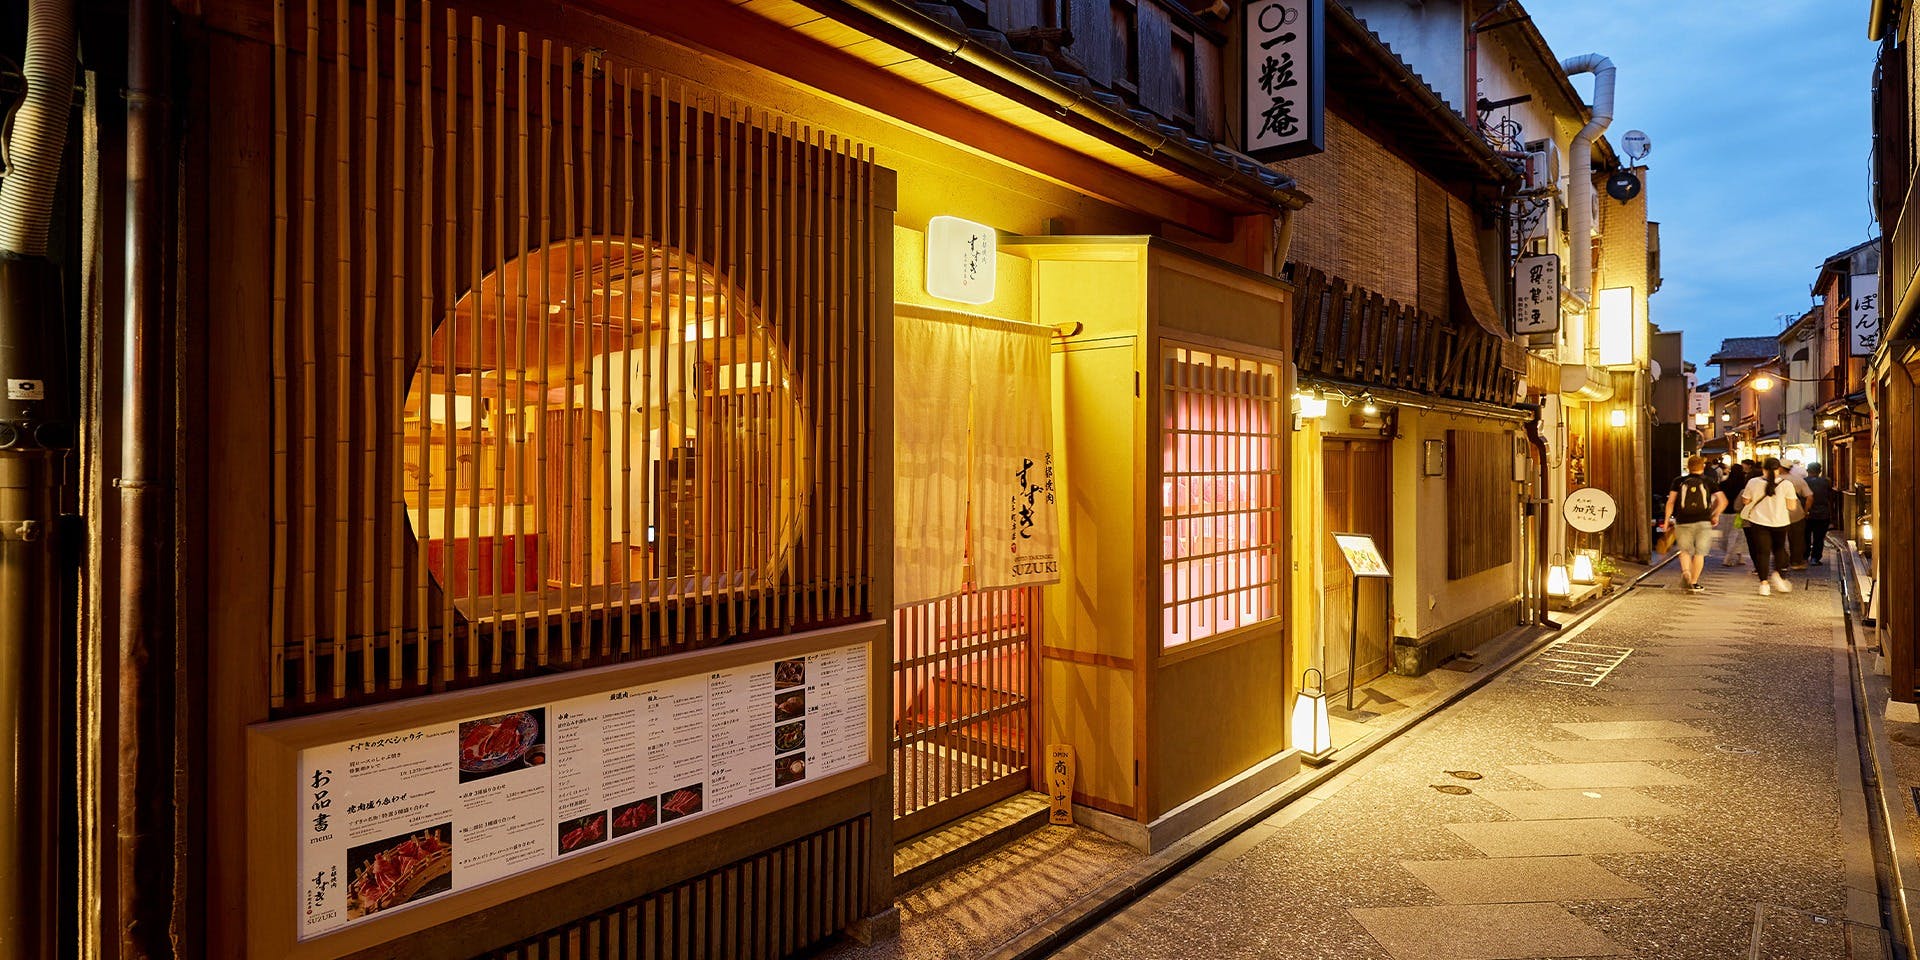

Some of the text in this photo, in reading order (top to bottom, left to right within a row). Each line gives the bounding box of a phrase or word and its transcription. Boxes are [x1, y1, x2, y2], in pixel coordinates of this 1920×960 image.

[1257, 32, 1298, 139] 一粒庵
[1016, 458, 1044, 538] すずき
[1012, 561, 1057, 577] SUZUKI
[312, 770, 332, 832] お品書
[310, 834, 333, 844] menu
[307, 911, 337, 926] SUZUKI
